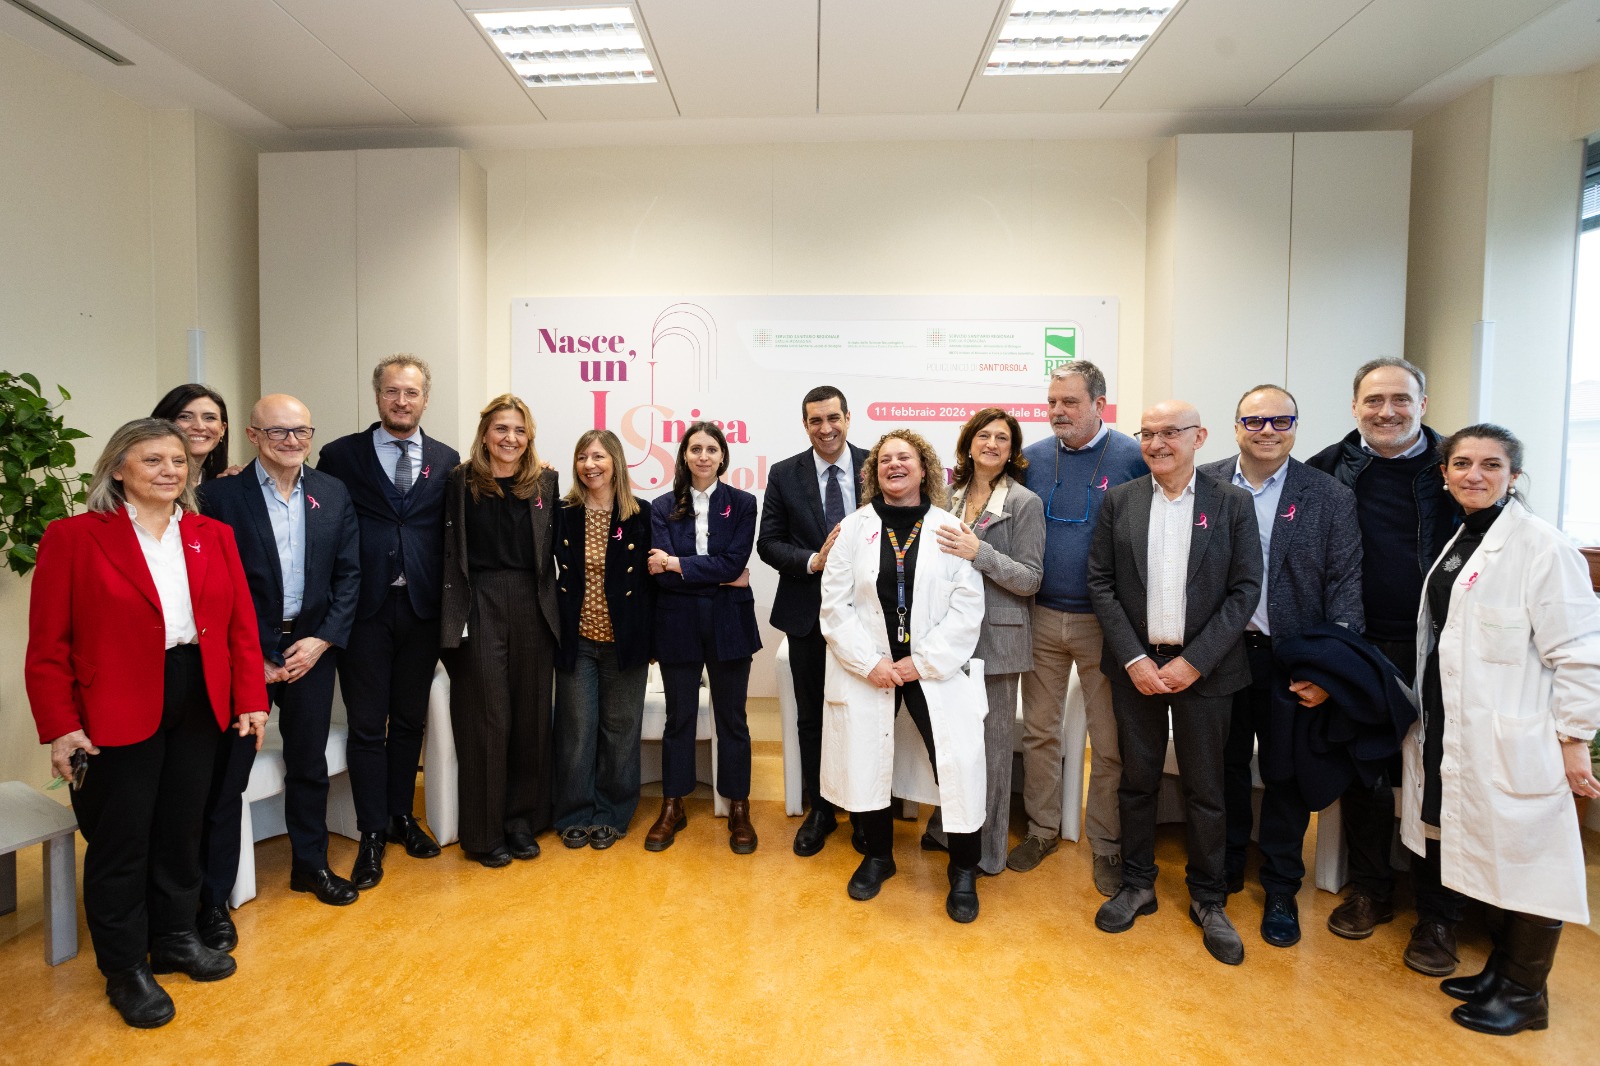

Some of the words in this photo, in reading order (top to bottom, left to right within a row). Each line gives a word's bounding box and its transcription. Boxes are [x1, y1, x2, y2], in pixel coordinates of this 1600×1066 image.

[979, 363, 1028, 372] SANT'ORSOLA
[874, 406, 887, 416] 11
[891, 406, 936, 417] febbraio
[940, 407, 967, 417] 2026
